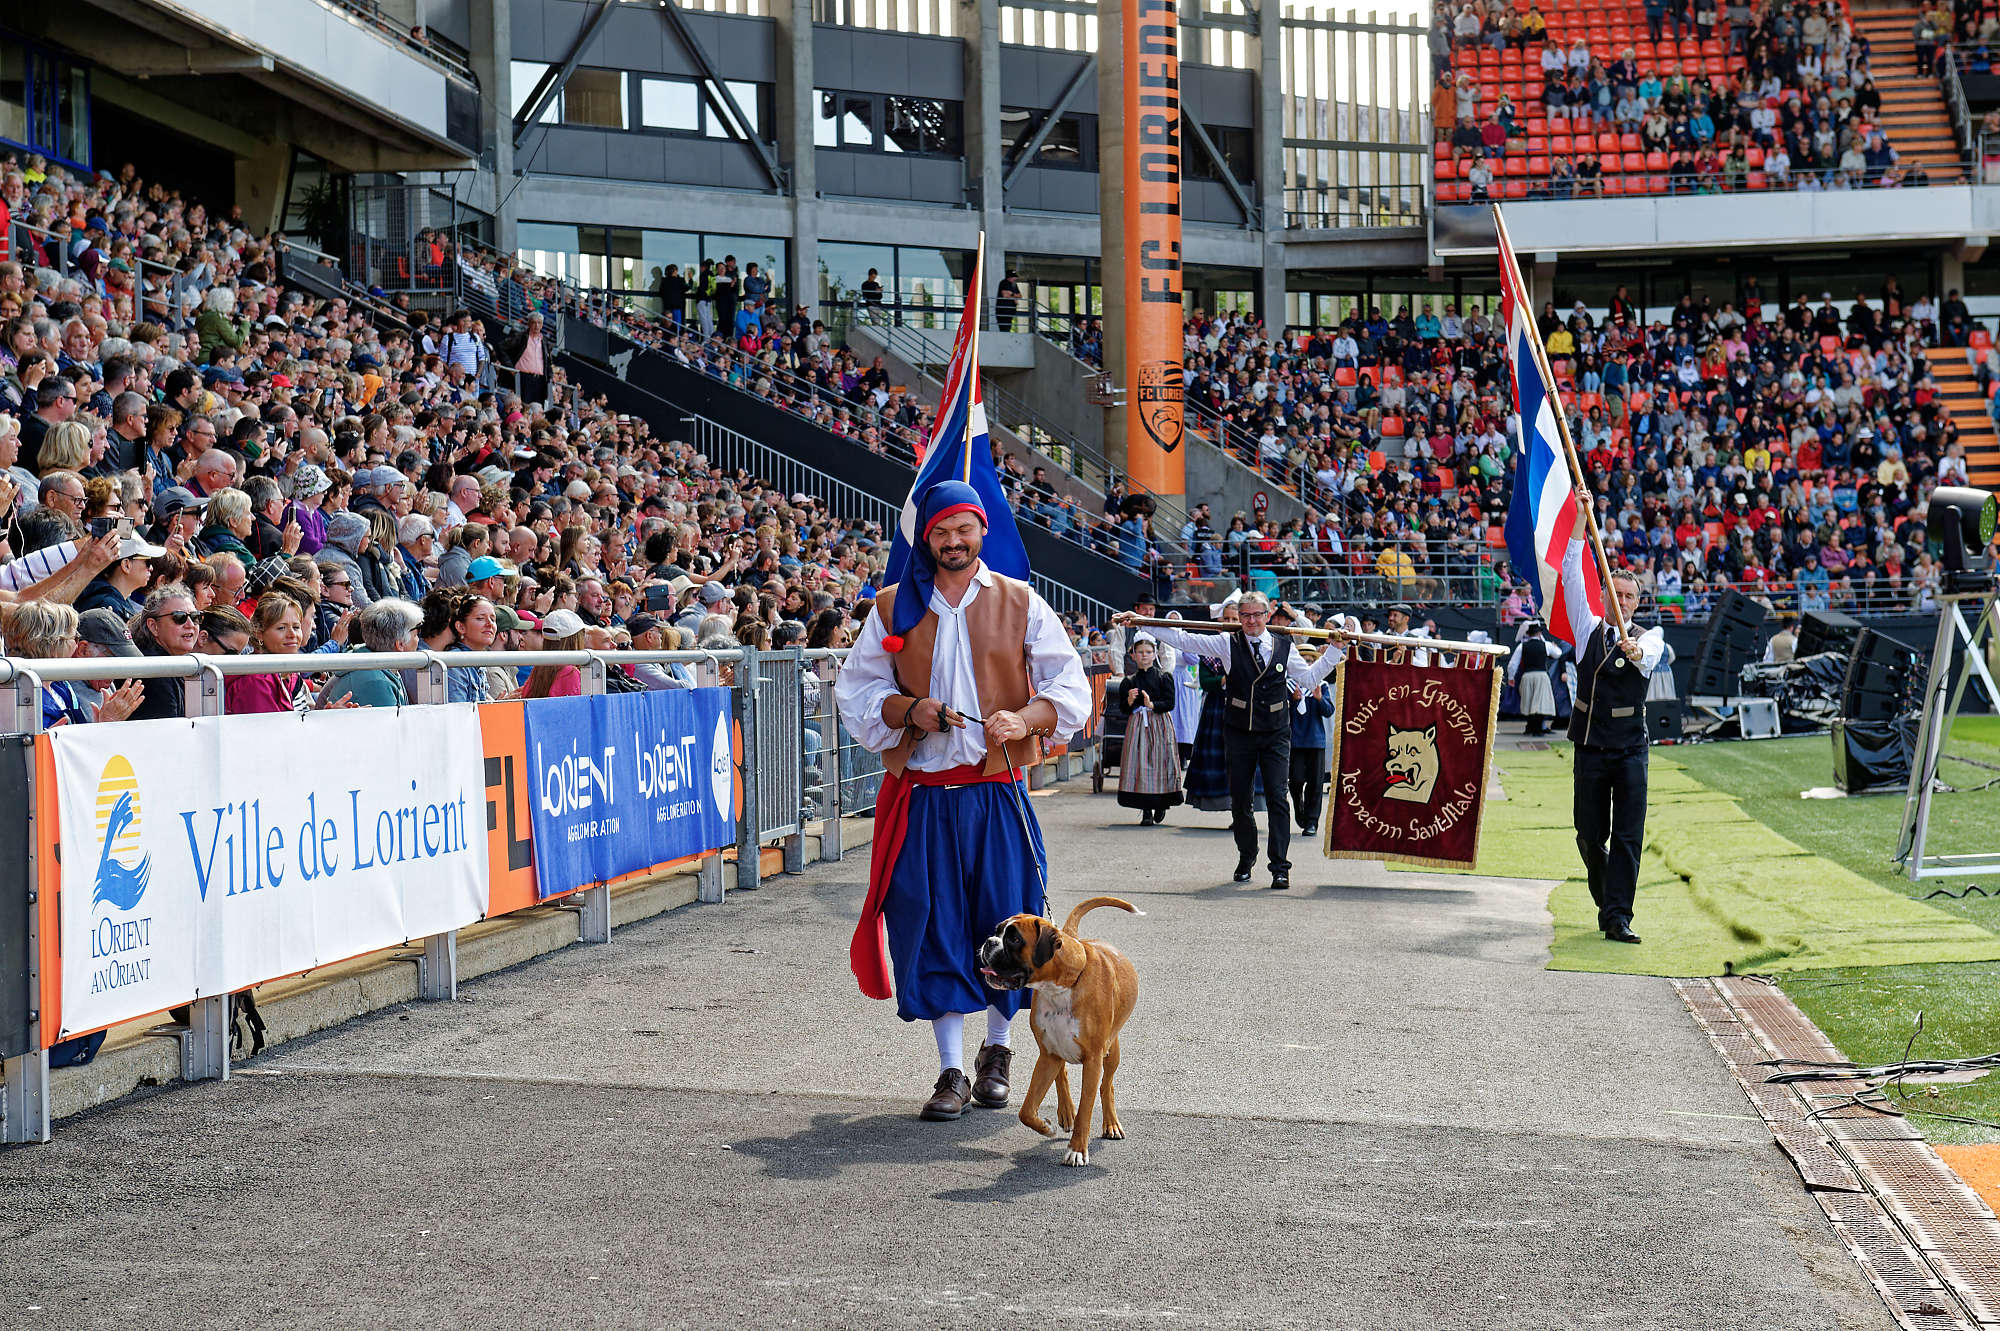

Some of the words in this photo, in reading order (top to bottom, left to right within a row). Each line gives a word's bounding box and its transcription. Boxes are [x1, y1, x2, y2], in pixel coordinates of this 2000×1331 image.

[1140, 240, 1182, 304] FC
[1140, 387, 1153, 400] FC
[1408, 780, 1477, 841] Sant-Malo
[179, 798, 285, 903] Ville
[298, 792, 338, 881] de
[348, 780, 469, 871] Lorient
[91, 917, 152, 958] LORIENT
